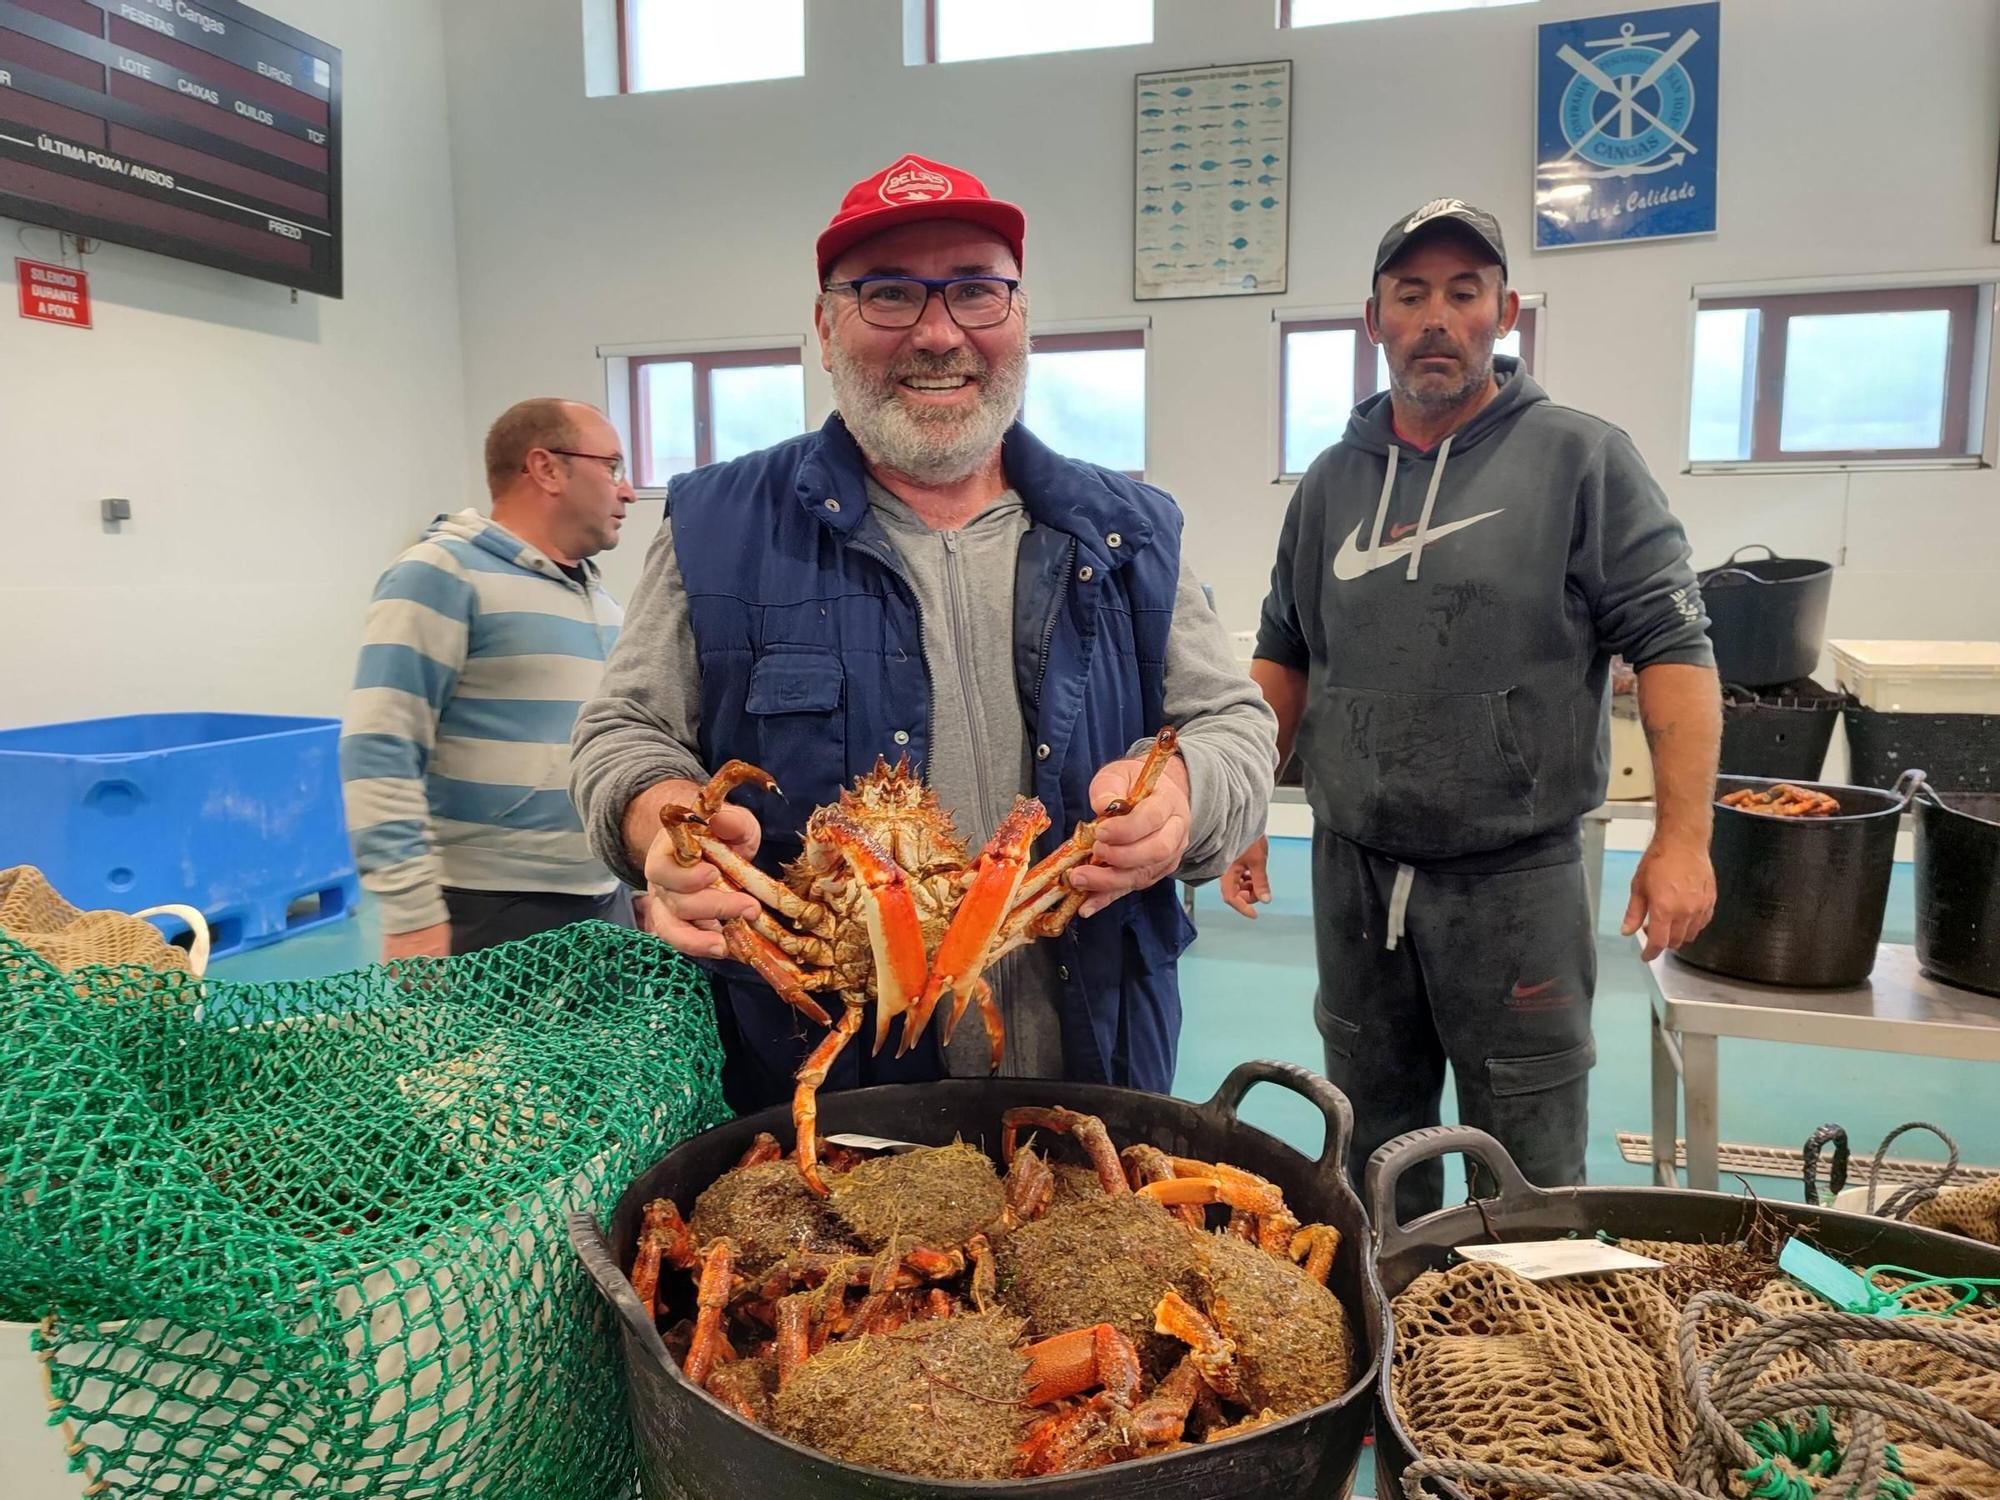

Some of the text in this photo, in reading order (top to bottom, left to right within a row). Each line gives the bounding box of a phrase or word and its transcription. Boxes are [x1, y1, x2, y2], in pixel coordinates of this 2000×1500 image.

[120, 3, 175, 37] PESETAS
[176, 1, 226, 34] Cangas
[257, 61, 292, 86] EUROS
[119, 56, 326, 144] LOTE CAIXAS QUILOS TCF
[1593, 135, 1660, 160] CANGAS
[37, 133, 87, 162] ÚLTIMA
[86, 150, 121, 173] POXA
[130, 165, 175, 189] AVISOS
[1626, 181, 1697, 212] Calidade
[268, 219, 302, 240] PREZO
[30, 267, 77, 288] SILENCIO
[31, 283, 80, 305] DURANTE
[38, 301, 76, 319] A POXA
